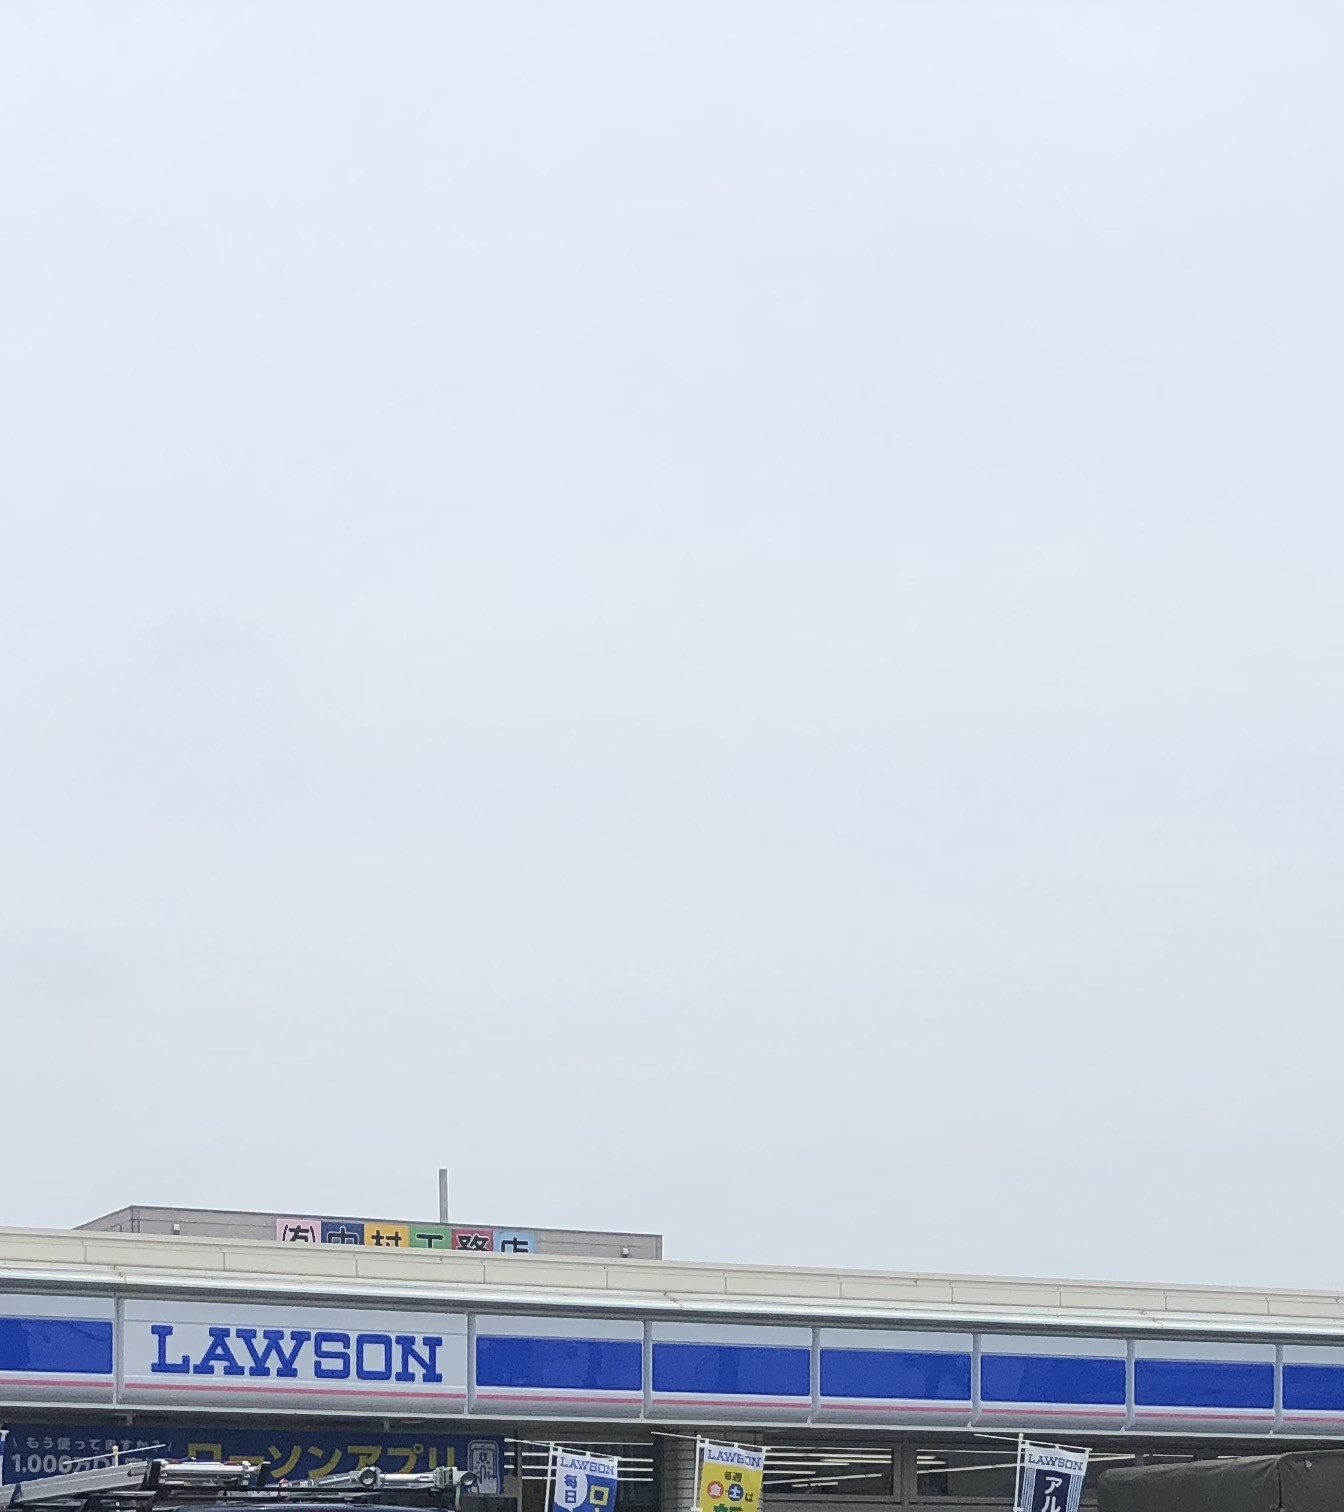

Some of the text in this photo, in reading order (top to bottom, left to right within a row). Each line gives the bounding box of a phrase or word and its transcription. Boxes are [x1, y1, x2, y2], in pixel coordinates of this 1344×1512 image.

[151, 1325, 443, 1383] LAWSON
[560, 1456, 615, 1476] LAWSON
[707, 1449, 762, 1468] LAWSON
[1027, 1453, 1084, 1472] LAWSON
[564, 1474, 578, 1504] 毎日
